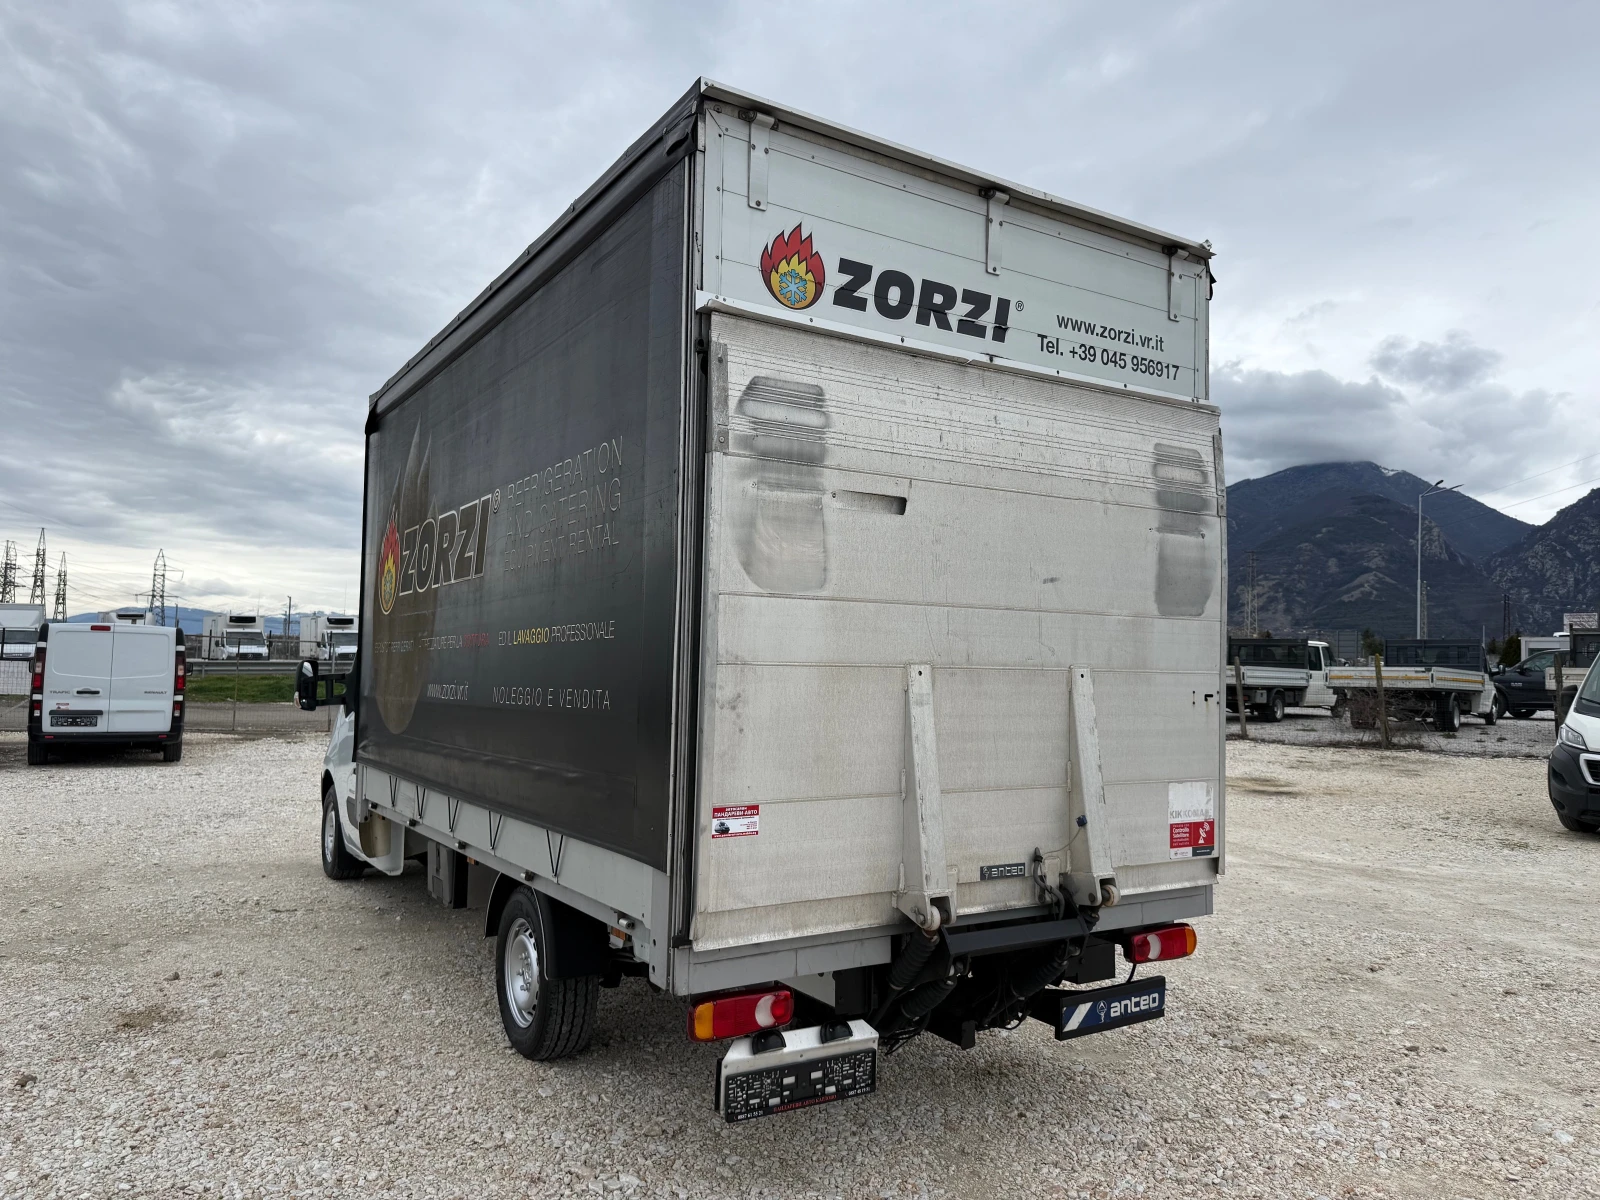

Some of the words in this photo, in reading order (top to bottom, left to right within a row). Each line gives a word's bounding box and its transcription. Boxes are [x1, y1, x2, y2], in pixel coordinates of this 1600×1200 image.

[1056, 314, 1164, 352] www.zorzi.vr.it
[1037, 333, 1064, 356] Tel.
[1069, 343, 1097, 363] +39
[1101, 349, 1127, 369] 045
[1131, 355, 1180, 381] 956917
[513, 627, 550, 645] LAVAGGIO
[550, 620, 615, 643] PROFESSIONALE
[492, 686, 543, 707] NOLEGGIO
[547, 688, 554, 707] E
[559, 688, 611, 710] VENDITA
[991, 865, 1025, 877] anteo
[1110, 992, 1159, 1018] anteo
